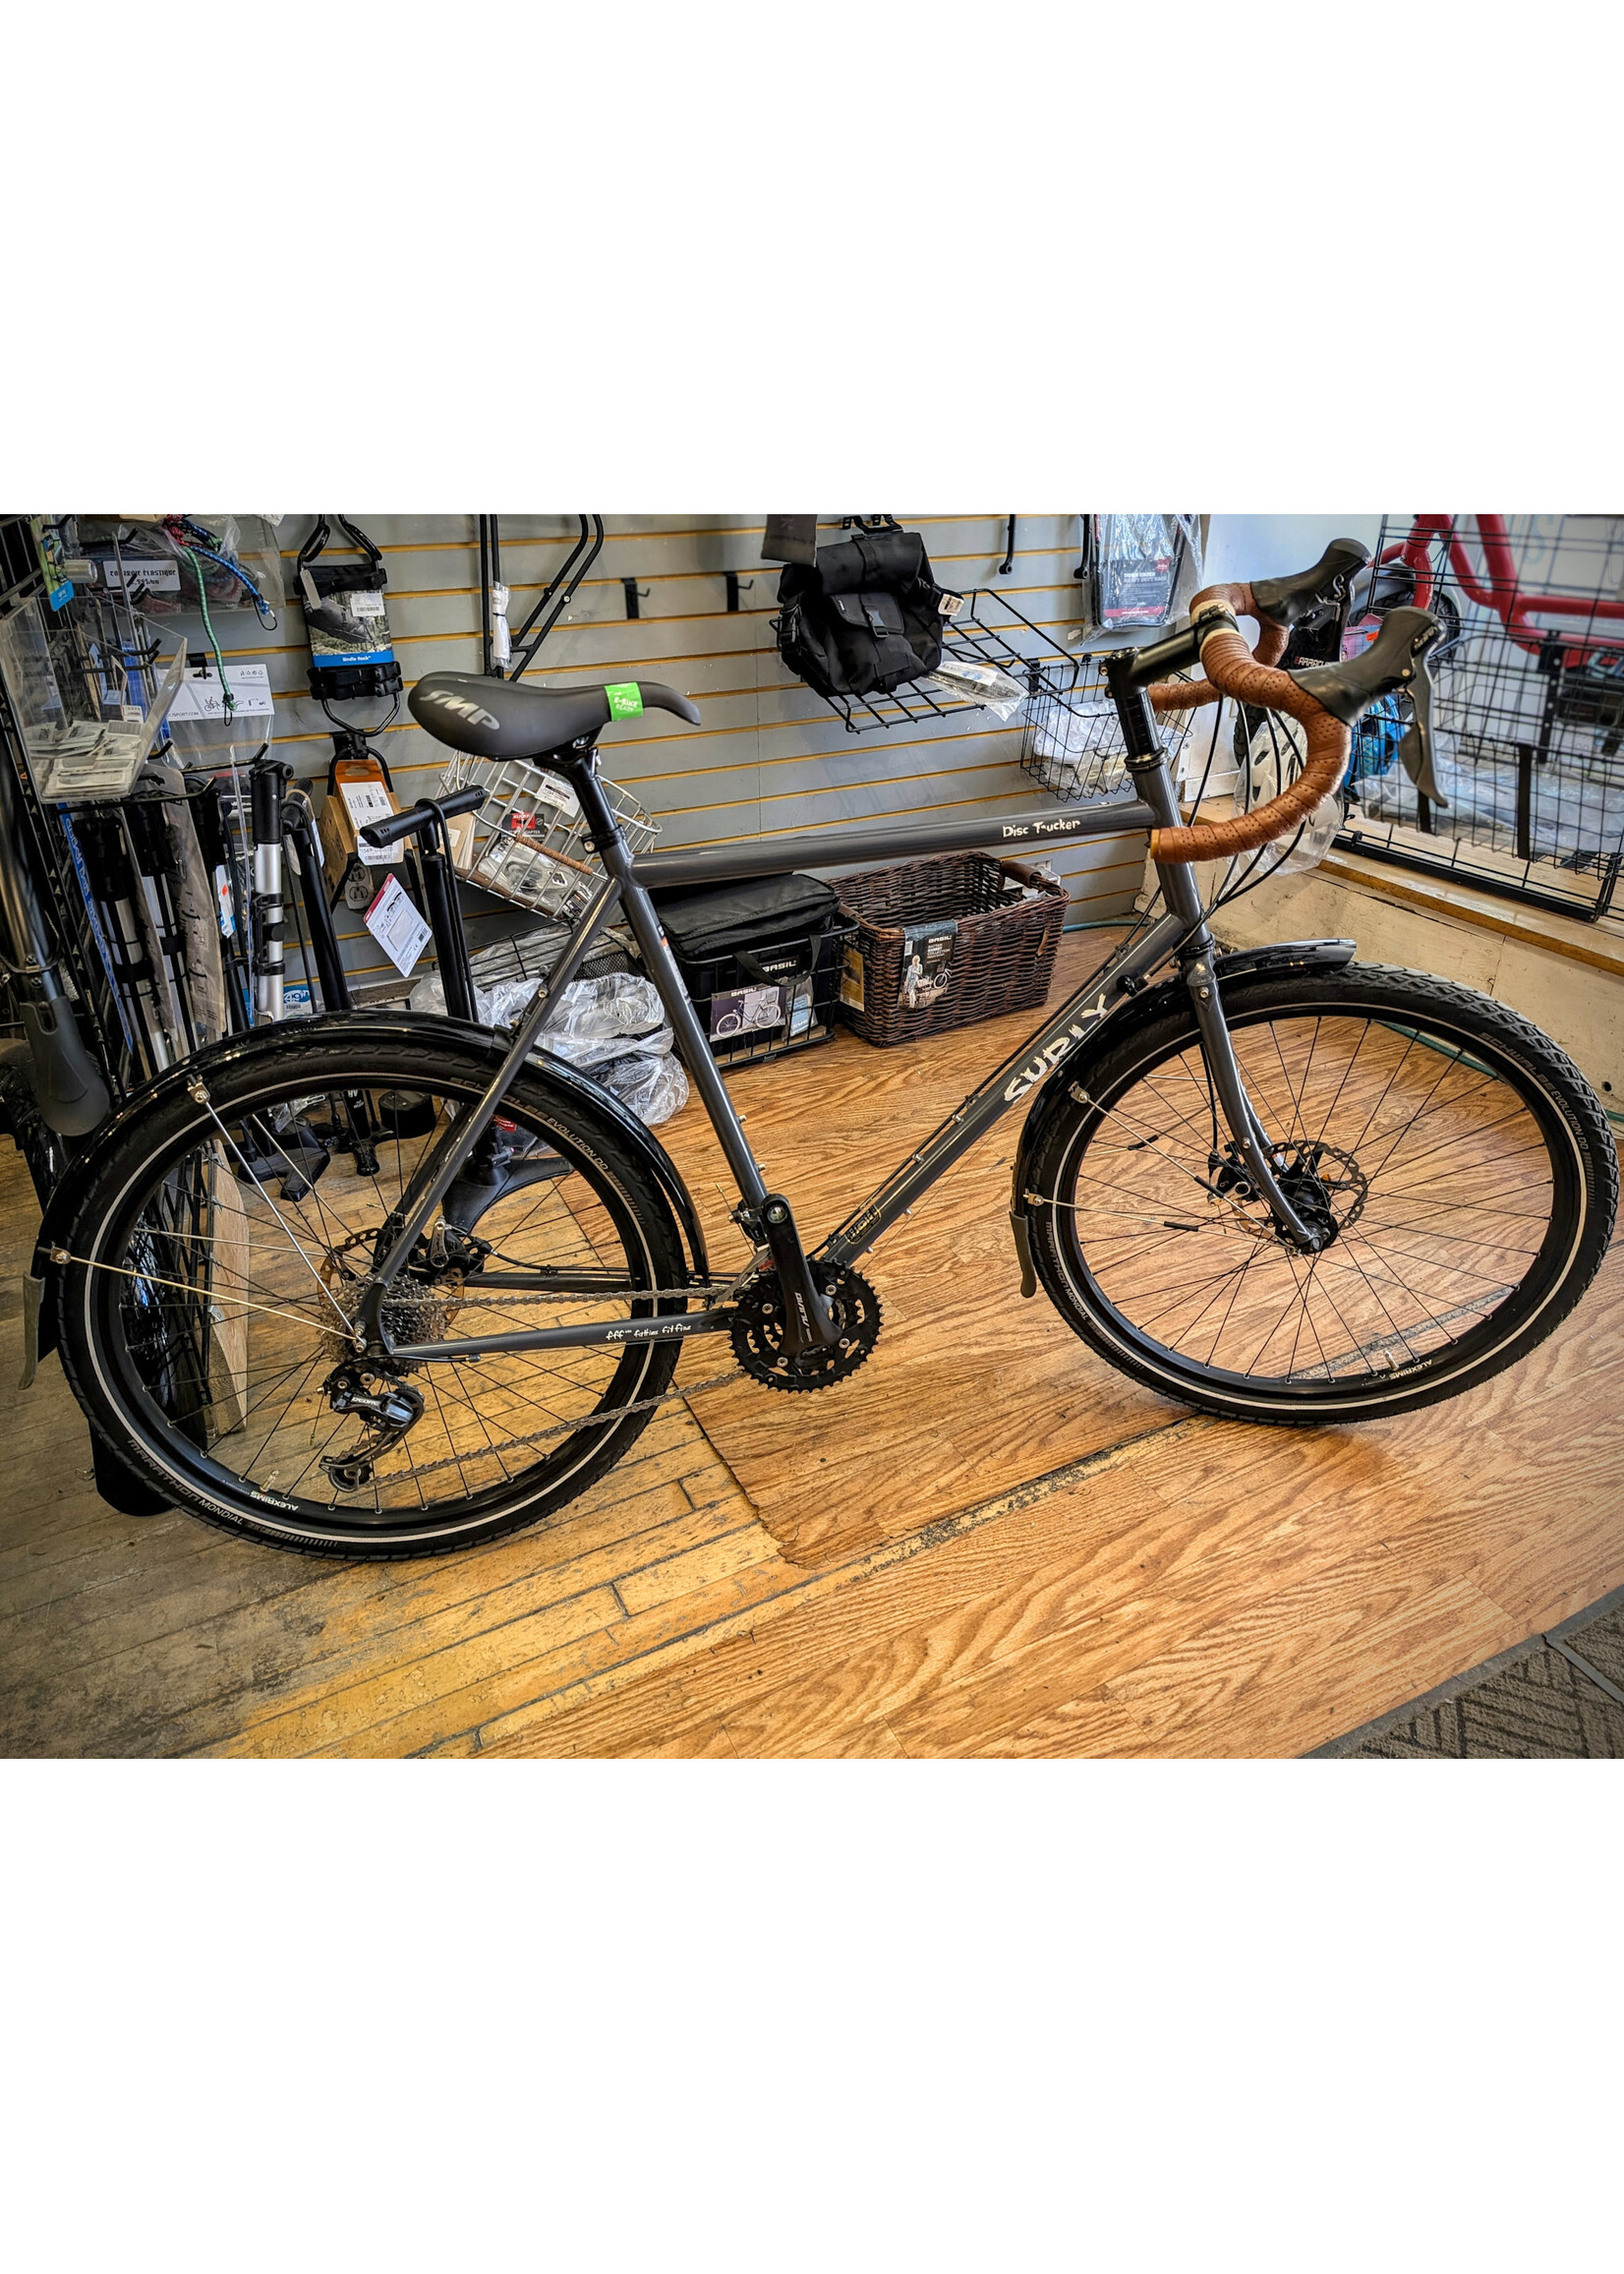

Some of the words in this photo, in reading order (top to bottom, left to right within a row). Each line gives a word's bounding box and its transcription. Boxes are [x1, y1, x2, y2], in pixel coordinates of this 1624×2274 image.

[419, 689, 500, 730] SMP
[1003, 824, 1029, 838] Disc
[730, 987, 757, 997] BASIL
[1004, 993, 1108, 1104] SURLY
[1478, 1032, 1555, 1091] SCHWALBE
[1550, 1089, 1584, 1137] EVOLUTION
[449, 1077, 549, 1120] SCHALBE
[547, 1117, 599, 1158] EVOLUTION
[1065, 1287, 1090, 1321] MONDIAL
[1388, 1359, 1432, 1380] ALEXRIMS
[351, 1396, 380, 1406] DEORE
[127, 1438, 201, 1503] MARATHON
[199, 1497, 244, 1526] MONDIAL
[250, 1489, 300, 1512] ALEXRIMS
